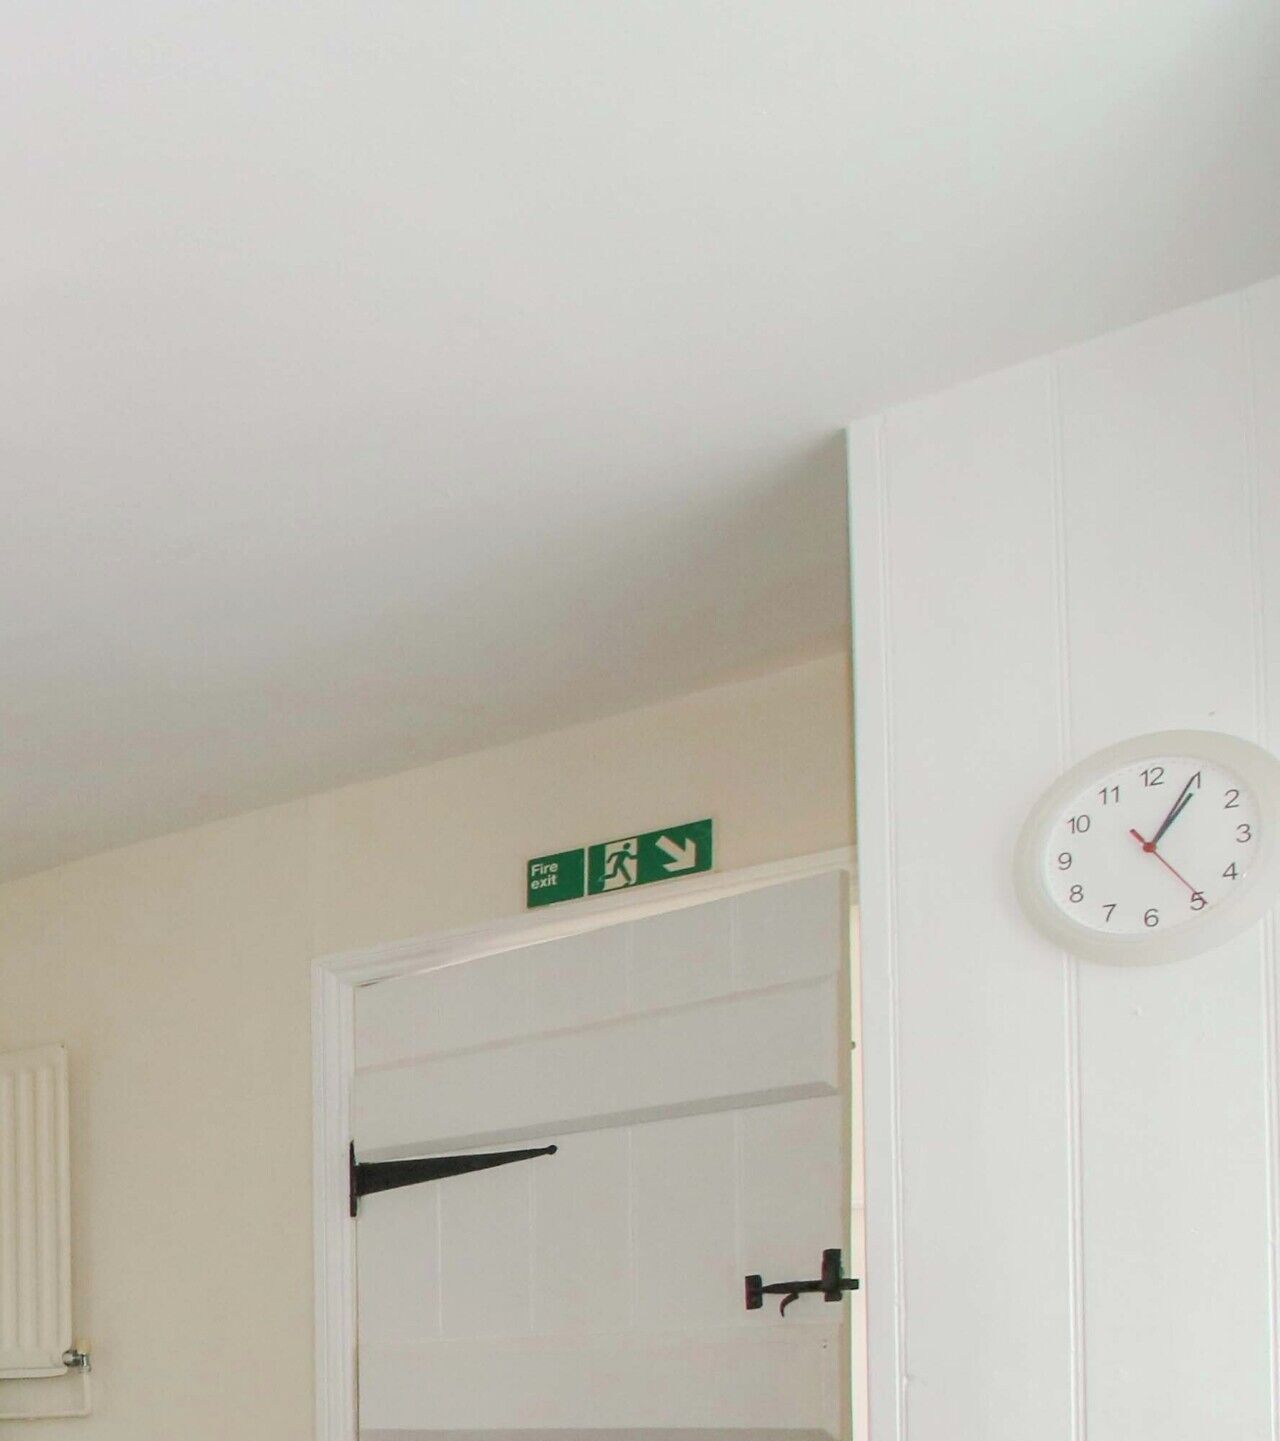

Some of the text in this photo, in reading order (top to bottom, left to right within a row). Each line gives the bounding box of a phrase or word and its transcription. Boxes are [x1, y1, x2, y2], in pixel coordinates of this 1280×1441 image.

[1140, 767, 1164, 787] 12
[1098, 785, 1120, 805] 11
[1224, 789, 1240, 809] 2
[1067, 815, 1091, 834] 10
[1236, 824, 1252, 843] 3
[531, 863, 558, 877] Fire
[1058, 852, 1073, 870] 9
[1223, 862, 1238, 880] 4
[531, 874, 557, 889] exit
[1069, 885, 1084, 903] 8
[1190, 891, 1206, 910] 5
[1102, 904, 1117, 922] 7
[1144, 909, 1159, 927] 6
